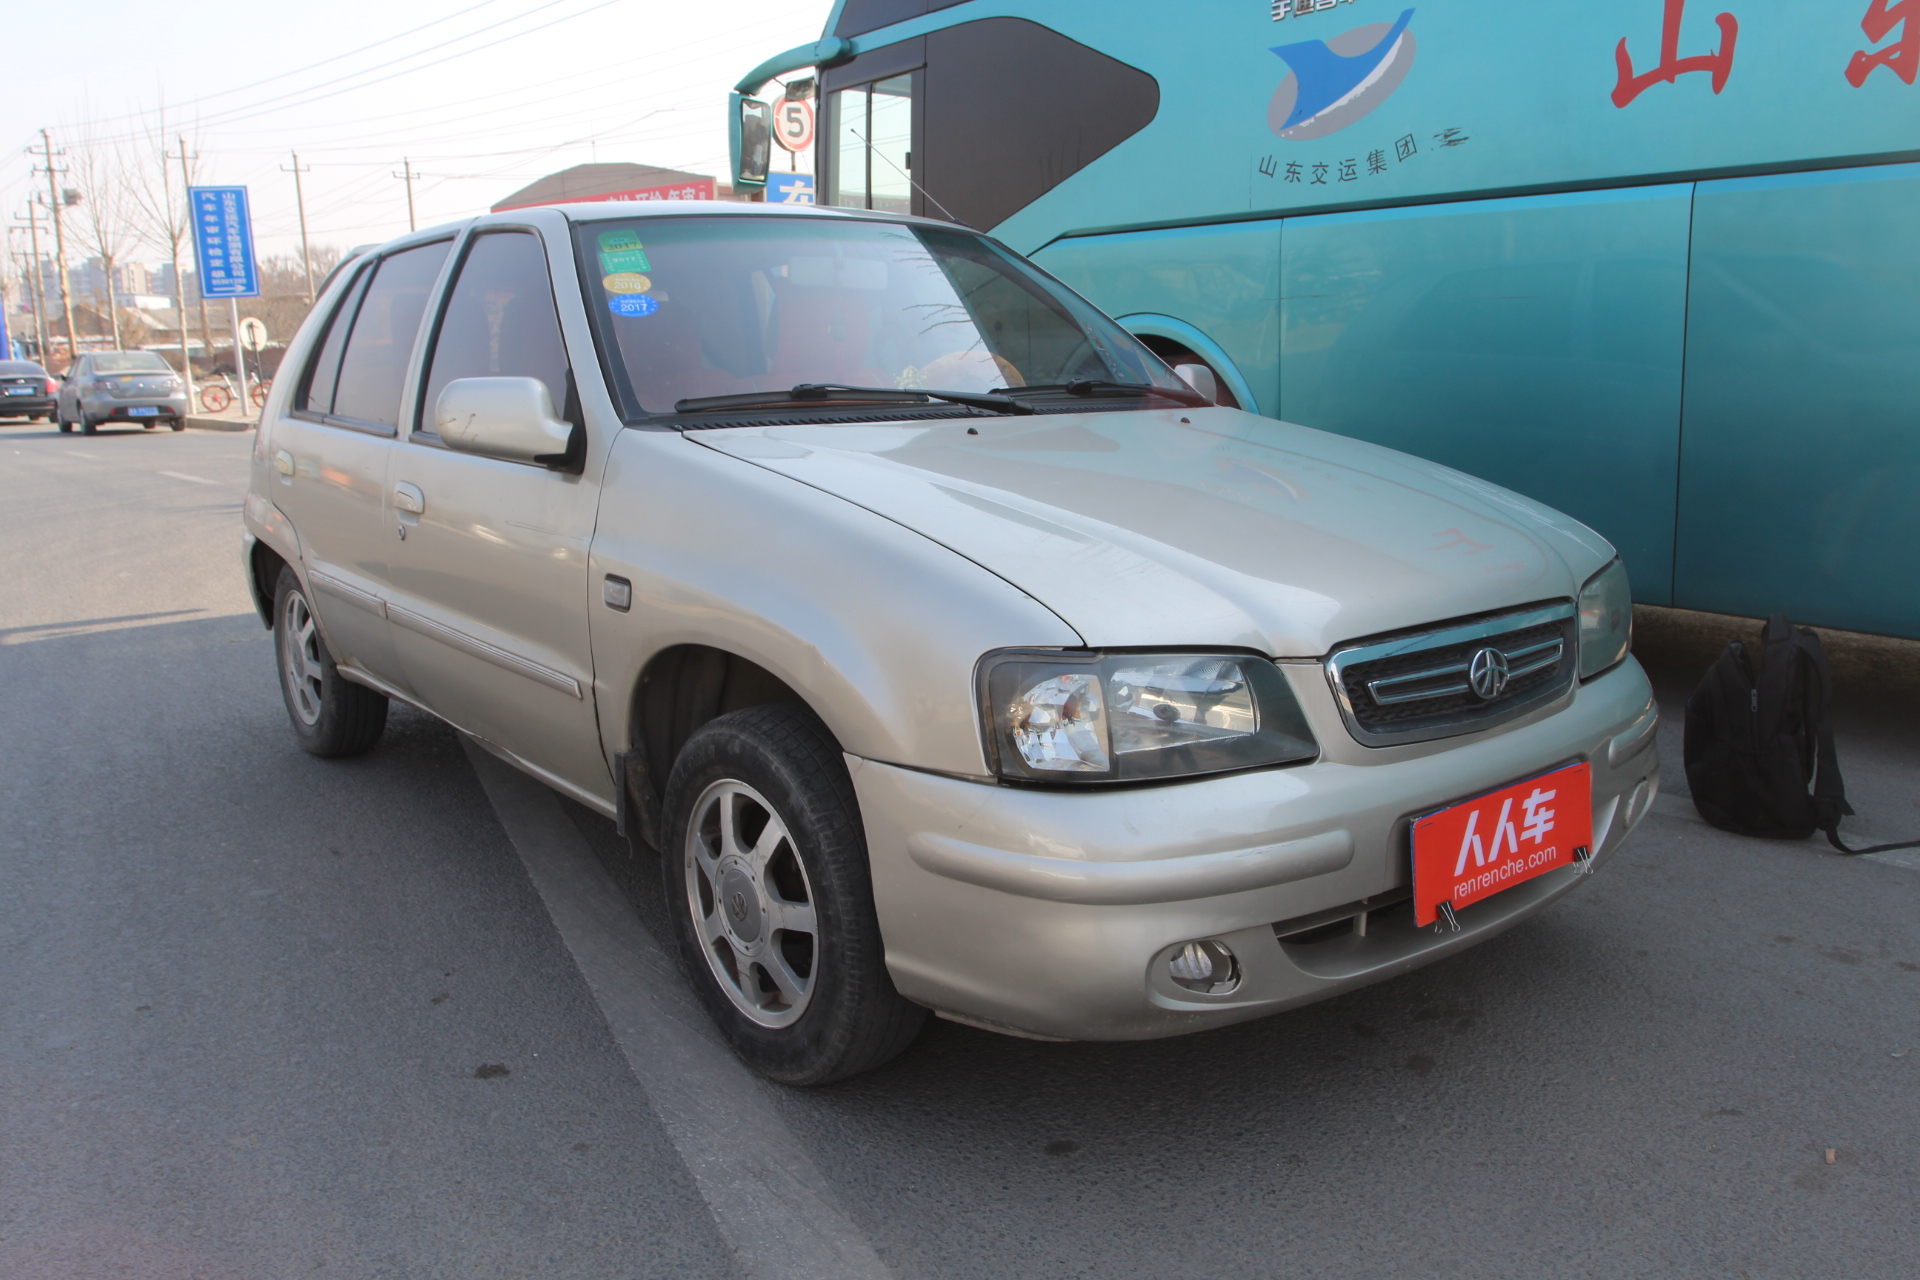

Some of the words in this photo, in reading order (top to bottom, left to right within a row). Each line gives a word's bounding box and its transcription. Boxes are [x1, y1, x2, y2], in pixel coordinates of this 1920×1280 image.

[786, 106, 804, 139] 5
[1258, 133, 1418, 185] 山东交运集团
[614, 281, 641, 290] 2016
[621, 303, 648, 312] 2017
[1454, 788, 1556, 877] 人人车
[1454, 846, 1556, 900] renrenche.com
